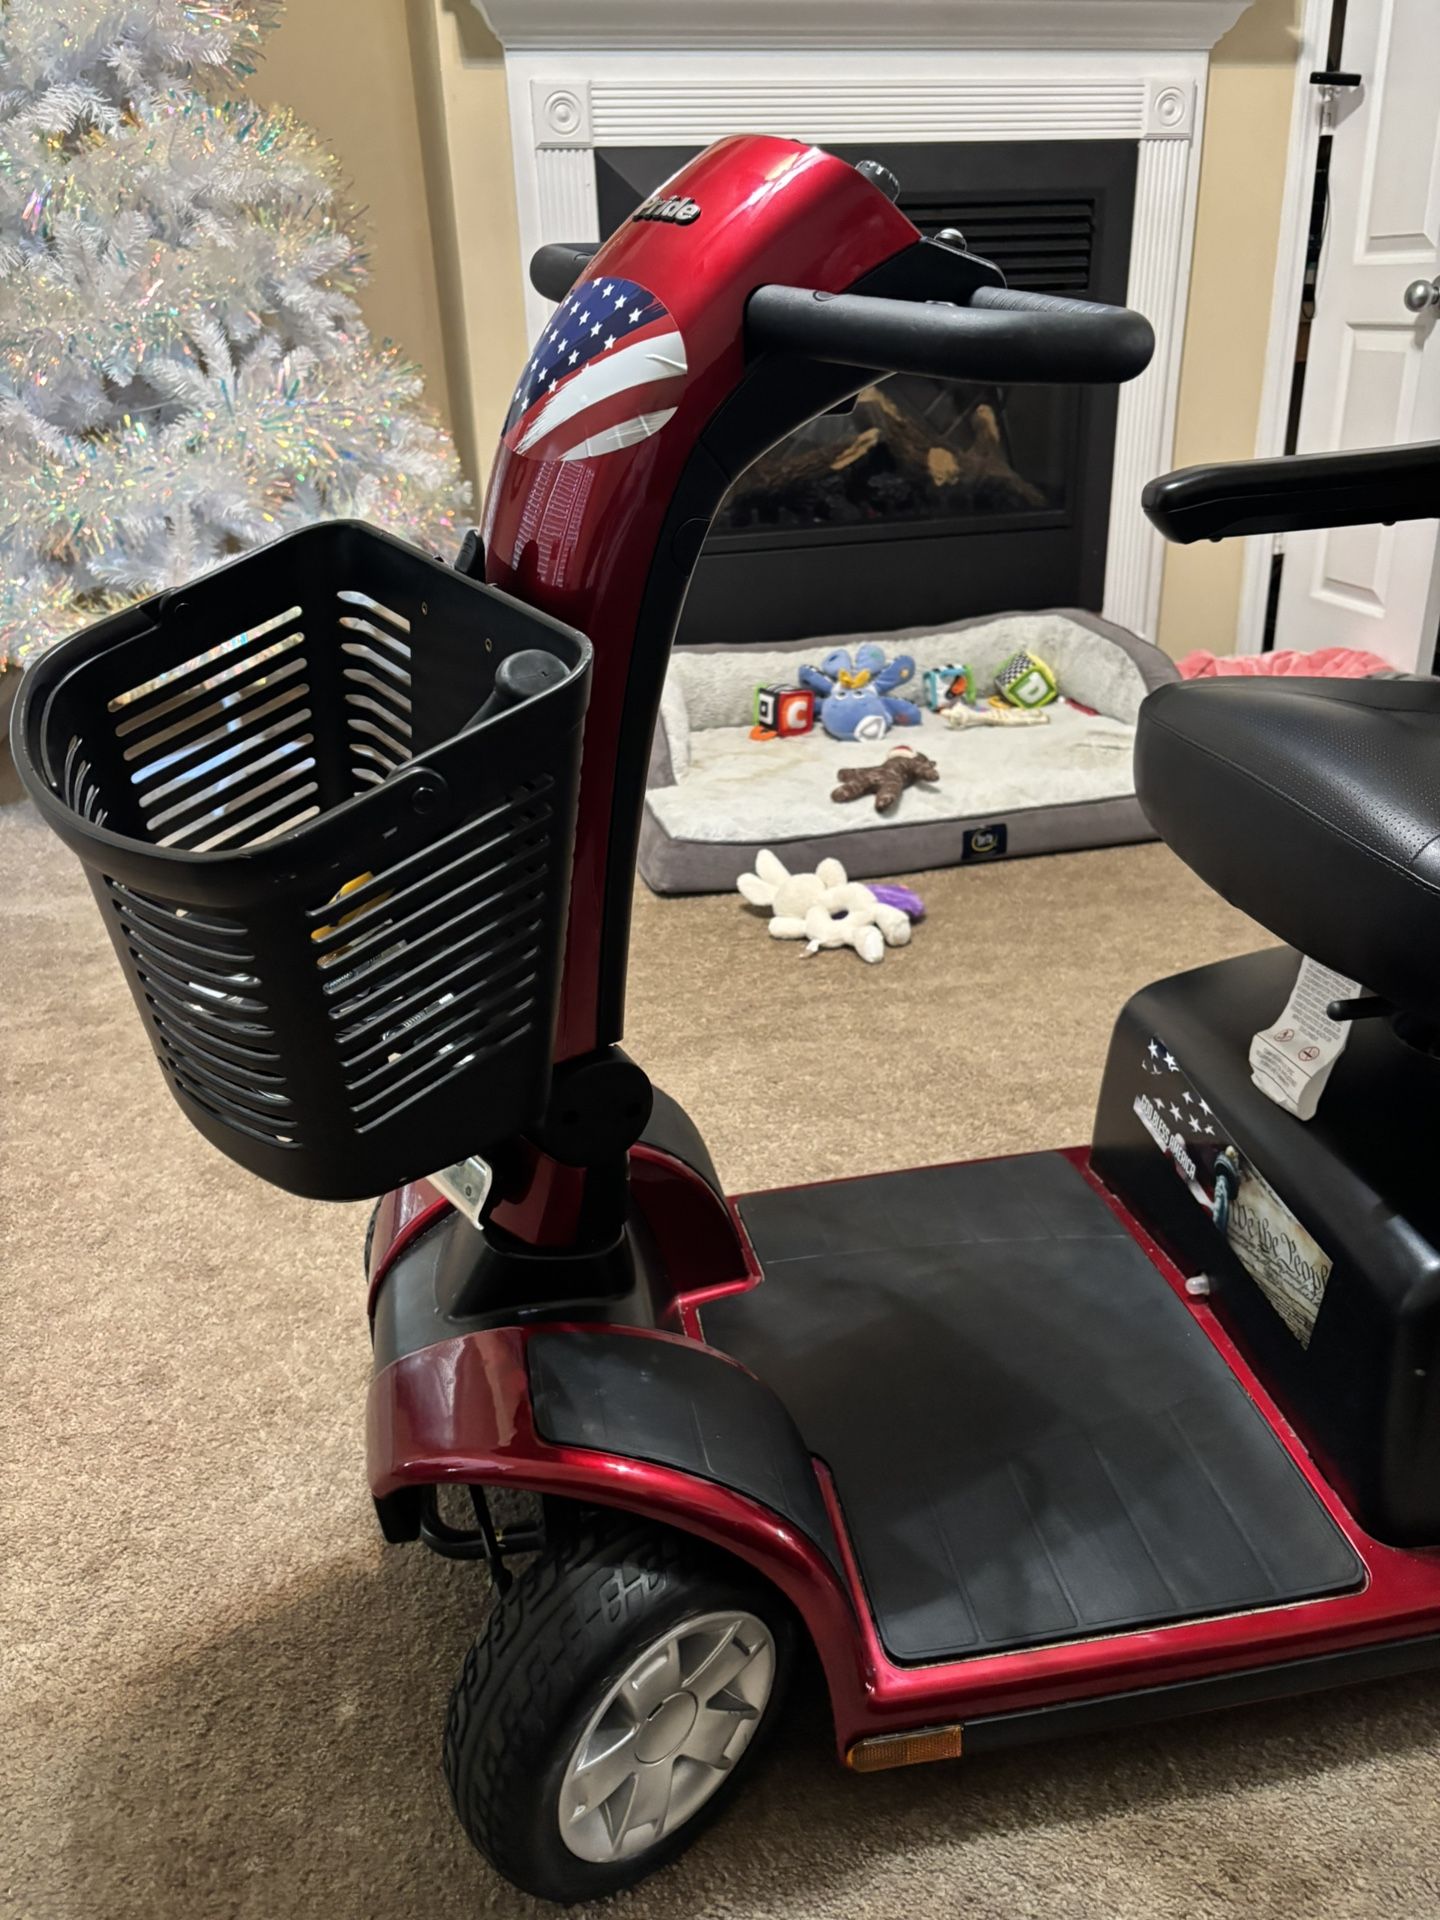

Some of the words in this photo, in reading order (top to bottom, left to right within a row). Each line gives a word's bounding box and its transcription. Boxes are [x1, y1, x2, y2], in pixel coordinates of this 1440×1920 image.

[632, 195, 701, 225] Pride
[787, 700, 807, 729] C
[1151, 1110, 1171, 1146] BLESS
[1168, 1134, 1197, 1181] AMERICA
